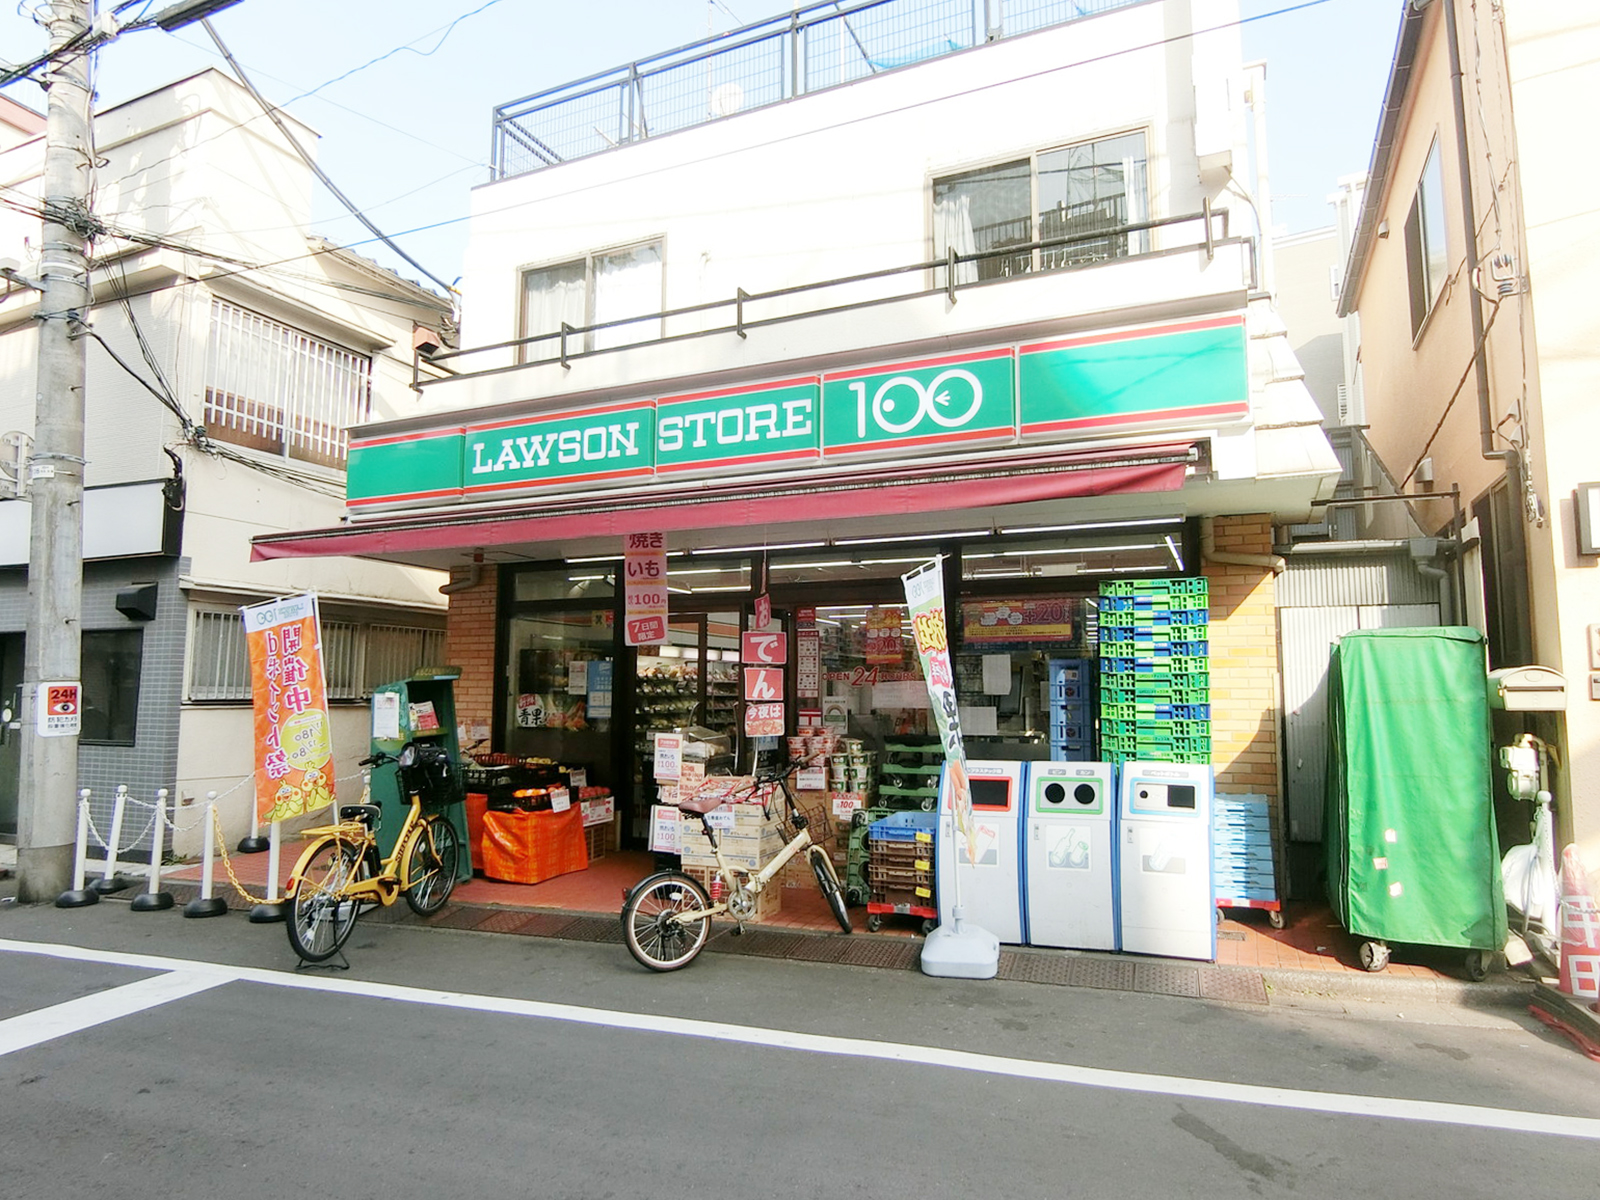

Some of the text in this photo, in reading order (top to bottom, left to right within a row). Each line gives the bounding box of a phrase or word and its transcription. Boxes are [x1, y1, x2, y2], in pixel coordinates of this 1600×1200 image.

[472, 368, 983, 474] LAWSON STORE 100
[629, 532, 663, 549] 焼き
[627, 560, 660, 577] いも
[822, 666, 917, 686] OPEN 24 HOURS
[51, 689, 77, 700] 24H
[747, 706, 781, 719] 今夜は
[840, 800, 854, 809] 100
